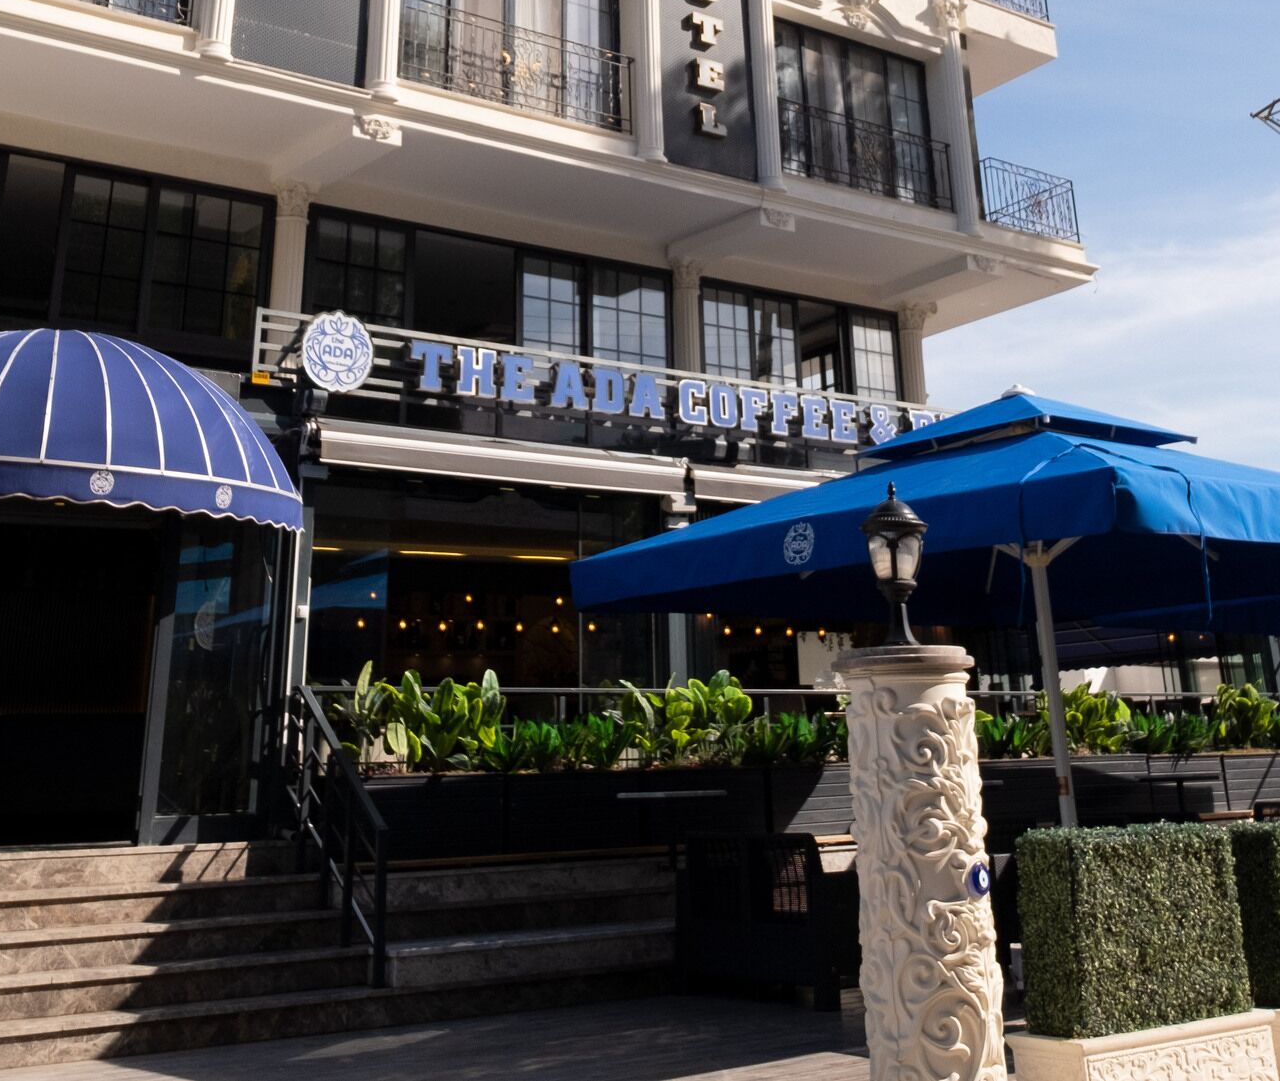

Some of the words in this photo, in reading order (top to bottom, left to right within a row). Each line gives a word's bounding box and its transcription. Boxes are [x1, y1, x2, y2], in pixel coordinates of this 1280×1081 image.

[323, 344, 353, 360] ADA
[410, 338, 537, 404] THE
[549, 360, 665, 419] ADA
[678, 379, 859, 444] COFFEE
[869, 404, 897, 445] &
